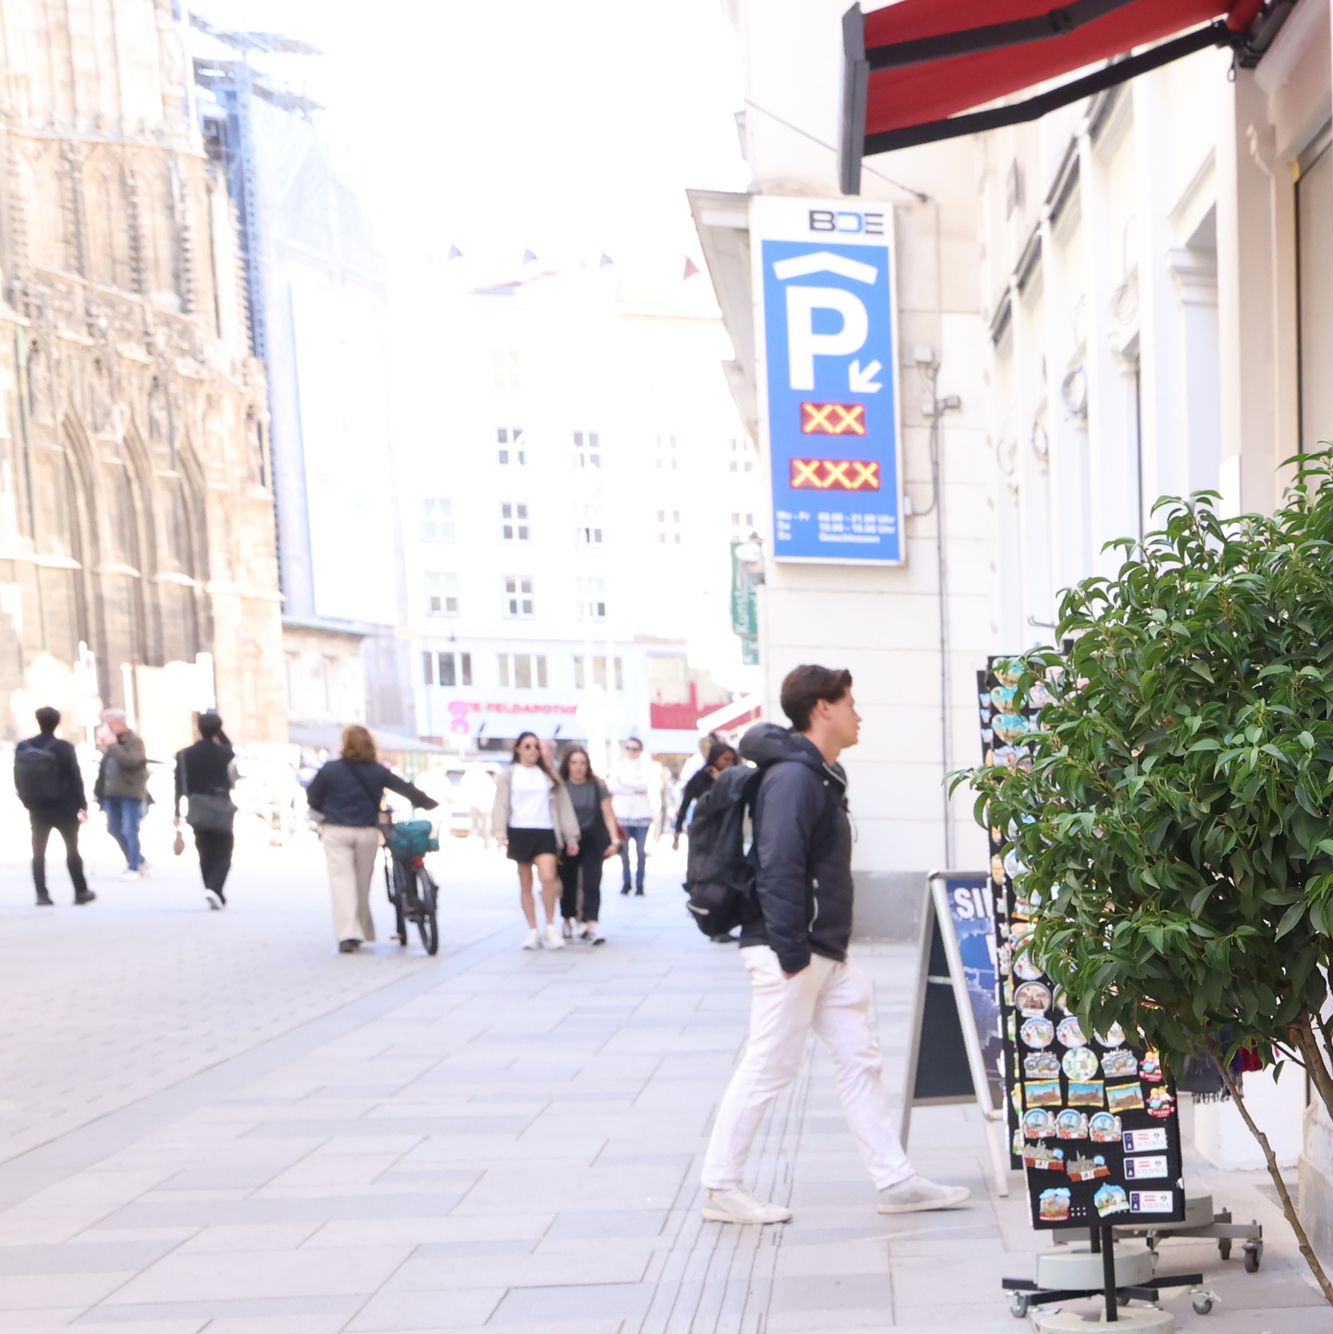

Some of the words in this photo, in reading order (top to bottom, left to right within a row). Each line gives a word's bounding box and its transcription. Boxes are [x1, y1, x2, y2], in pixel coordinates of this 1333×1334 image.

[786, 285, 868, 390] P
[802, 403, 865, 435] XX
[791, 459, 879, 489] XXX
